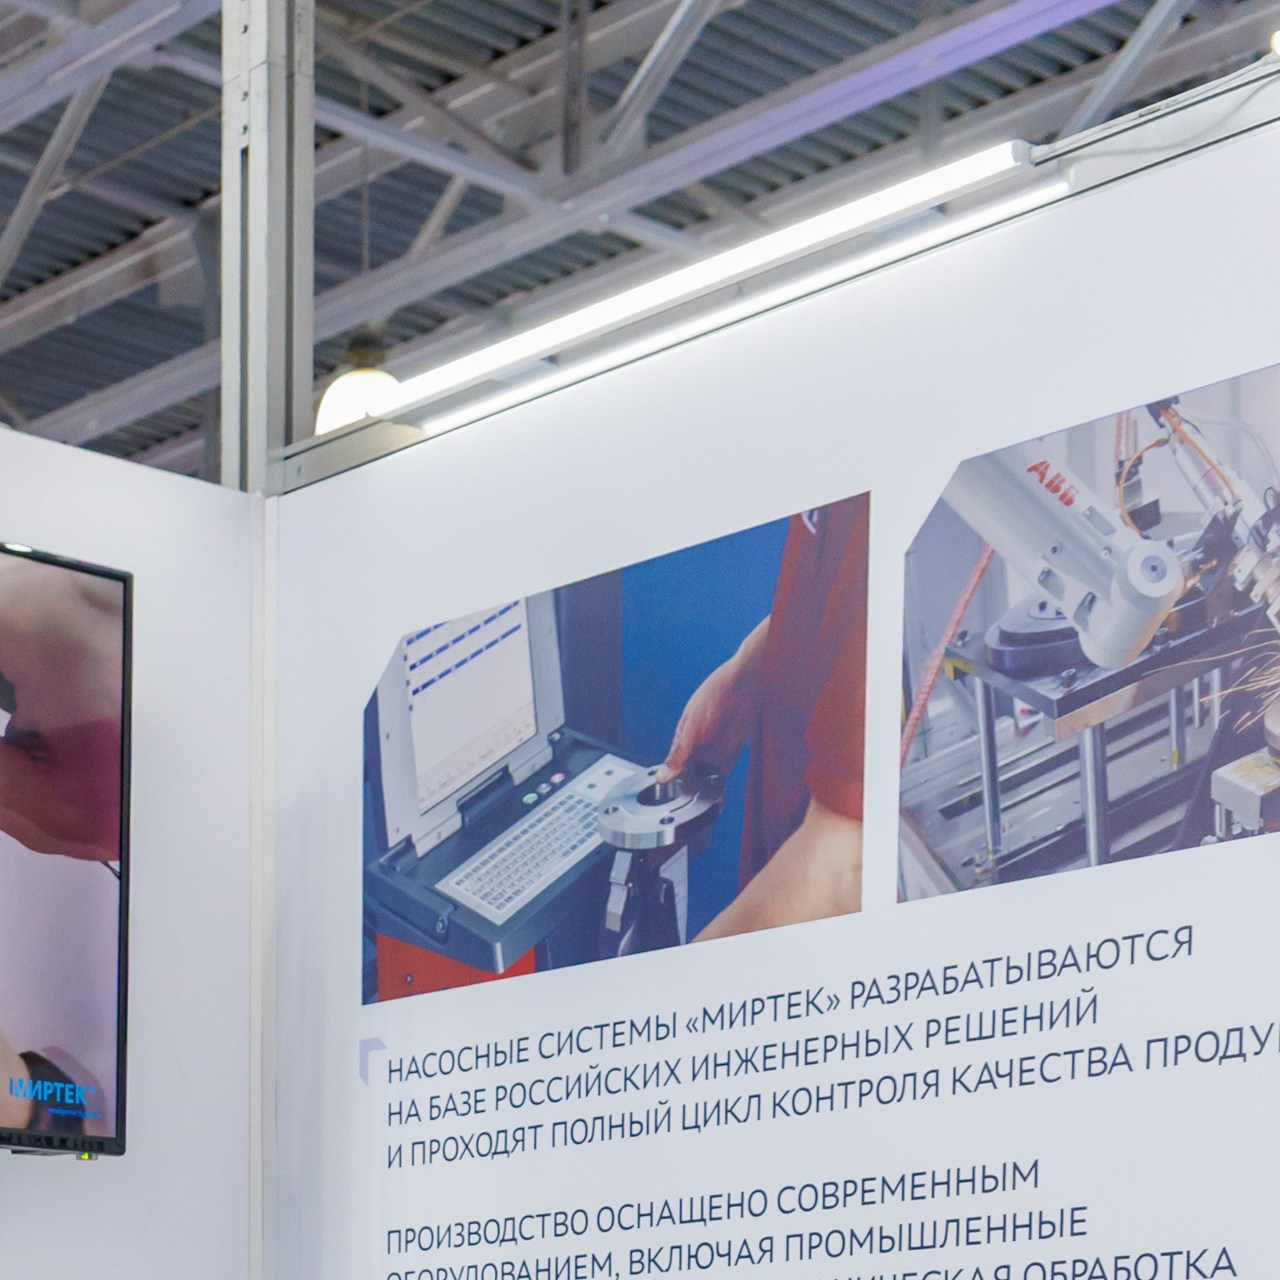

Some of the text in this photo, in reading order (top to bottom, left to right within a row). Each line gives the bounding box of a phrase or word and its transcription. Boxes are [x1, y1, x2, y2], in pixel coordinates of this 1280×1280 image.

[1026, 460, 1078, 507] ABB
[389, 925, 1192, 1083] НАСОСНЫЕ СИСТЕМЫ «МИРТЕК» РАЗРАБАТЫВАЮТСЯ
[389, 987, 1097, 1126] НА БАЗЕ РОССИЙСКИХ ИНЖЕНЕРНЫХ РЕШЕНИЙ
[388, 1023, 1280, 1168] И ПРОХОДЯТ ПОЛНЫЙ ЦИКЛ КОНТРОЛЯ КАЧЕСТВА ПРОДУ
[388, 1159, 1038, 1254] ПРОИЗВОДСТВО ОСНАЩЕНО СОВРЕМЕННЫМ
[629, 1236, 773, 1275] ВКЛЮЧАЯ
[786, 1206, 1087, 1261] ПРОМЫШЛЕННЫЕ
